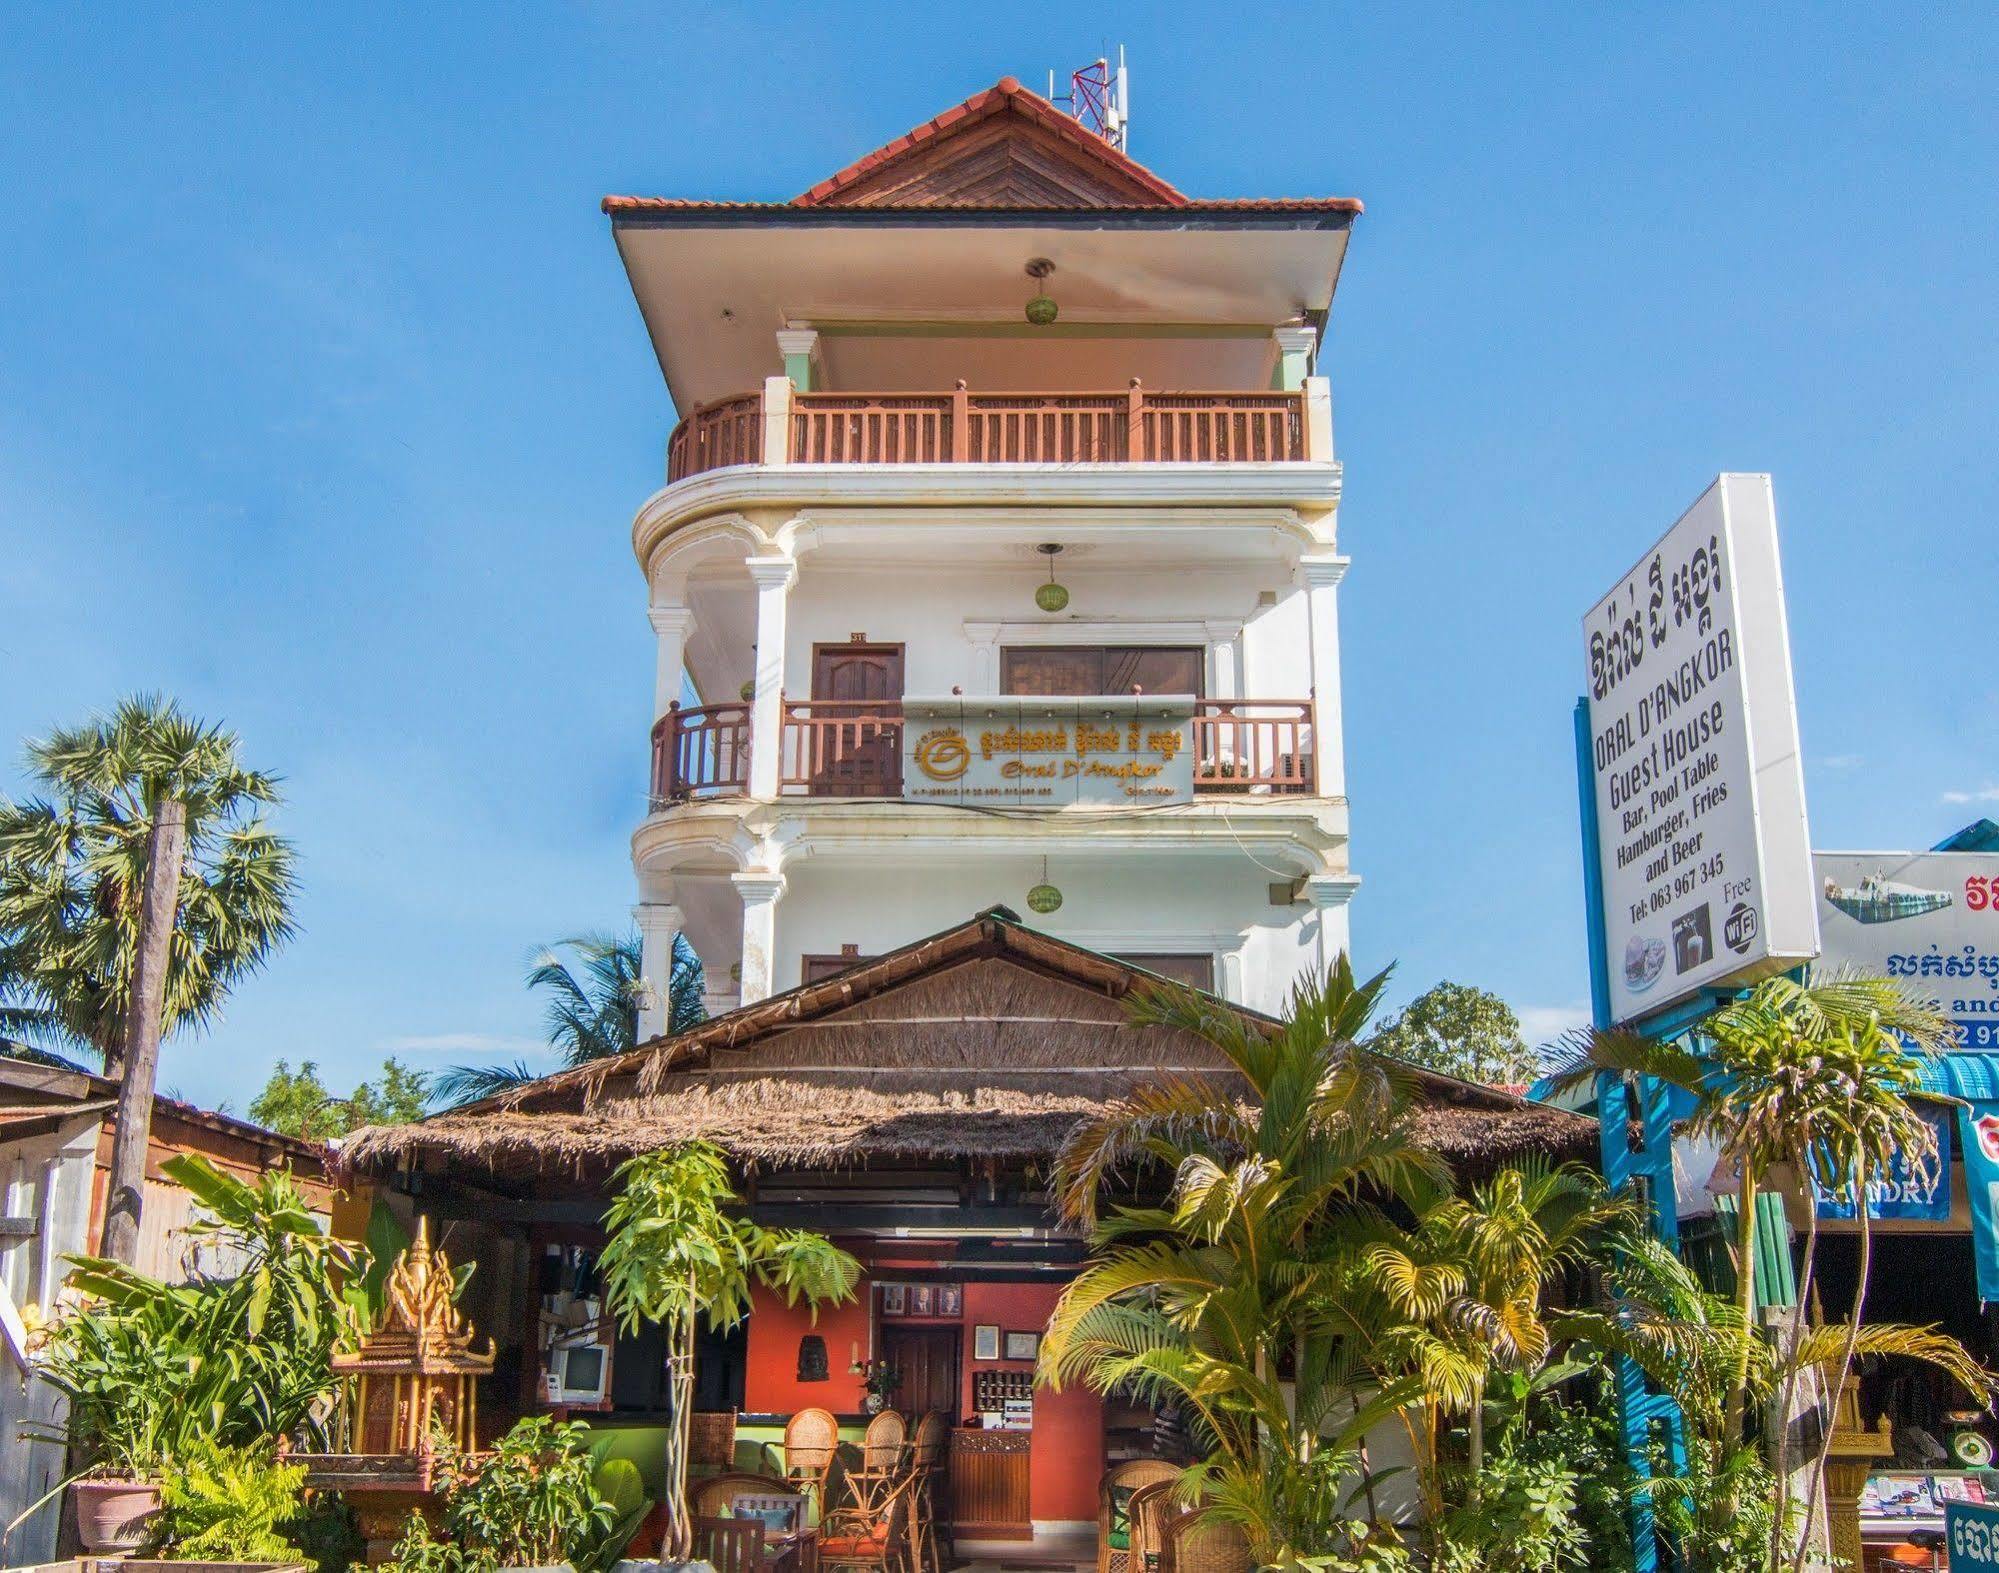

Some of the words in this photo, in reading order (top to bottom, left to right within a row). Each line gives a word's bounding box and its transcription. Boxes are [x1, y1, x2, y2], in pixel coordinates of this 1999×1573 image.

[1672, 535, 1721, 637] អង្គរ
[1595, 712, 1635, 772] ORAL
[1639, 628, 1732, 738] D'ANGKOR
[1002, 759, 1056, 778] Oral
[1062, 759, 1164, 787] D'Angkor
[1610, 742, 1659, 811] Guest
[1663, 701, 1723, 772] House
[1622, 806, 1648, 835] Bar,
[1651, 776, 1679, 814] Pool
[1681, 753, 1719, 791] Table
[1617, 809, 1689, 869] Hamburger,
[1692, 782, 1727, 819] Fries
[1646, 849, 1668, 883] and
[1672, 832, 1703, 866] Beer
[1630, 902, 1647, 924] Tel:
[1650, 885, 1671, 912] 063
[1675, 869, 1696, 899] 967
[1700, 853, 1724, 885] 345
[1723, 877, 1751, 904] Free
